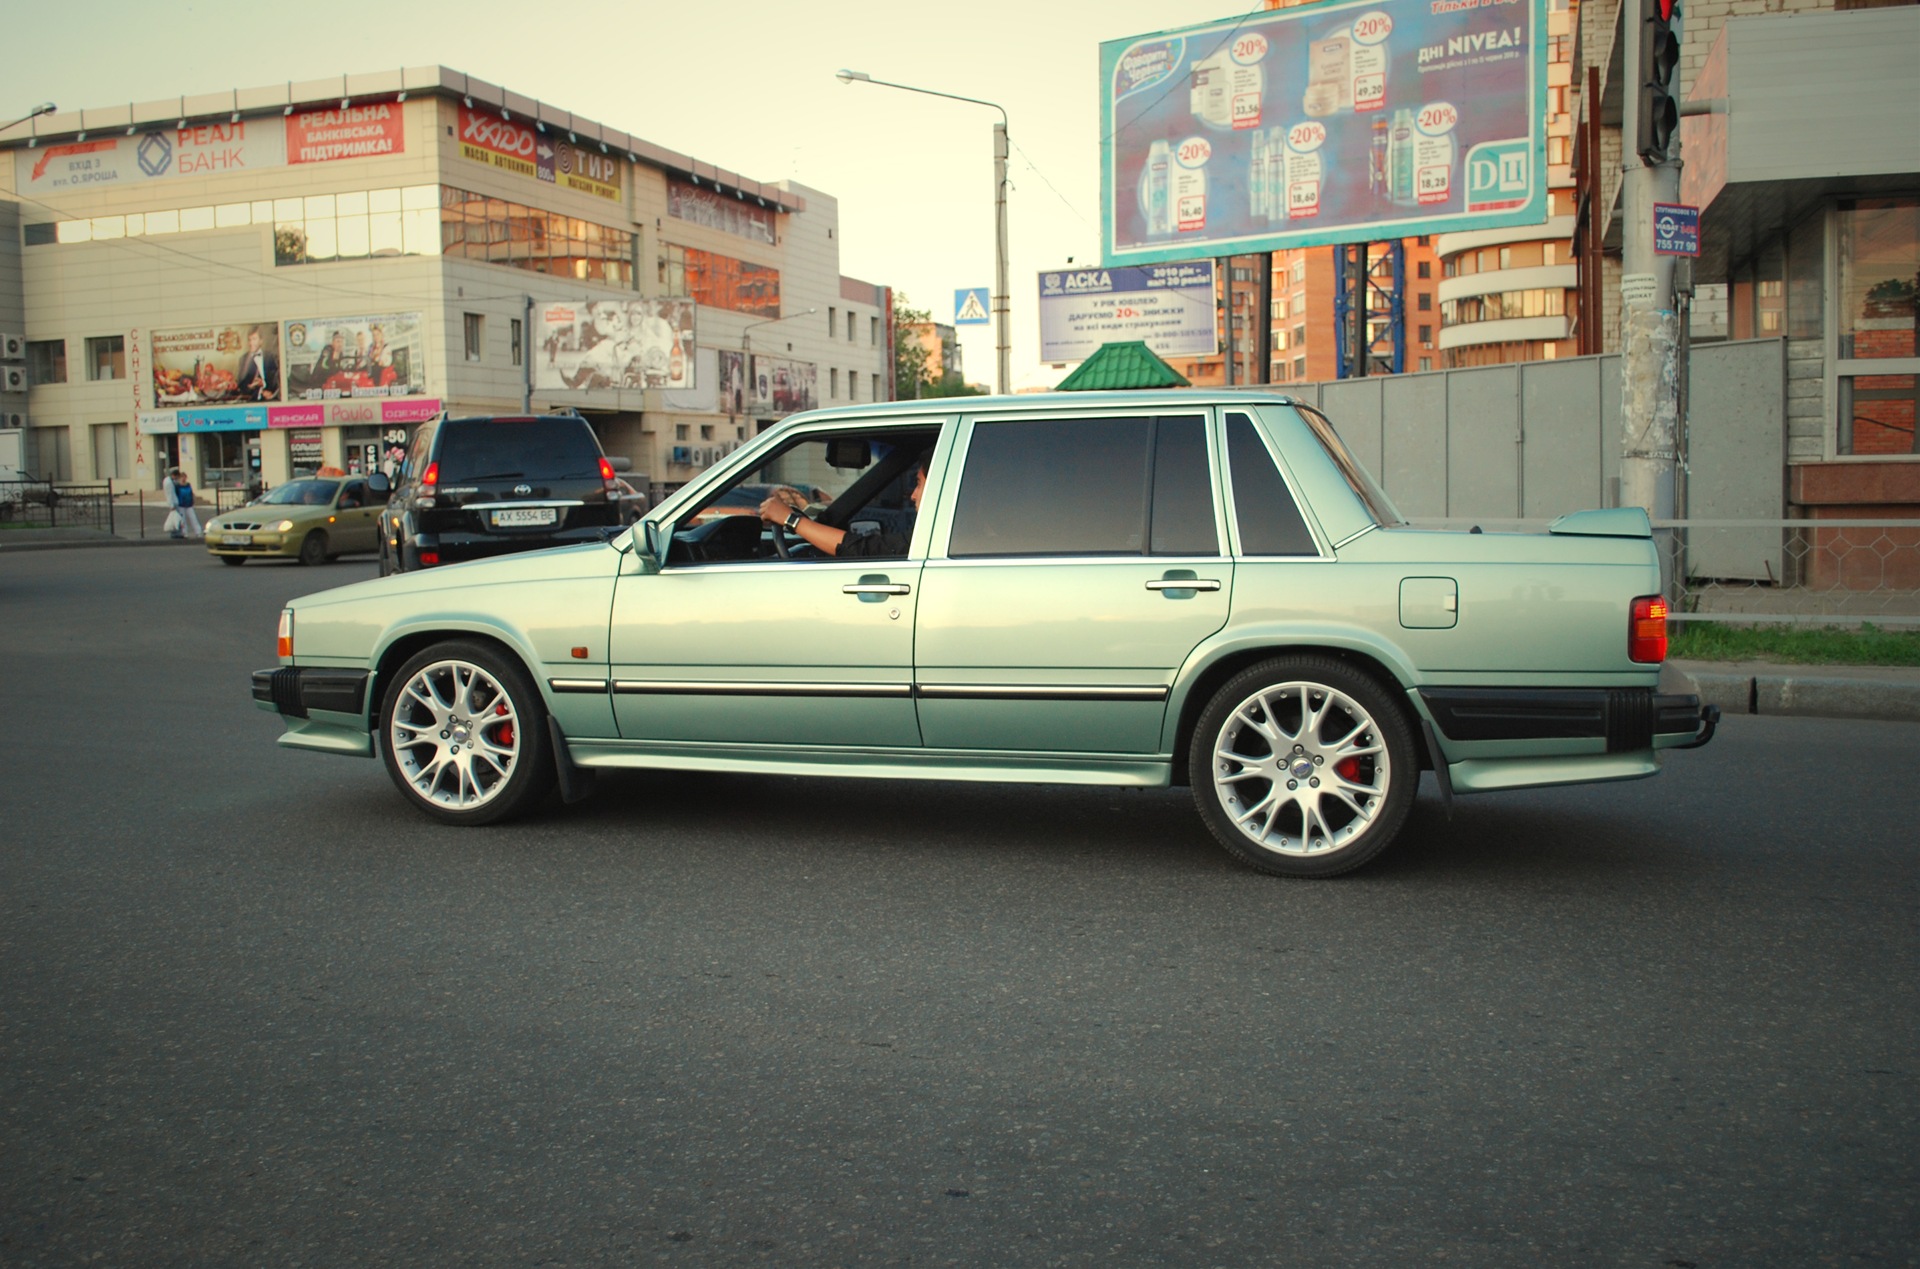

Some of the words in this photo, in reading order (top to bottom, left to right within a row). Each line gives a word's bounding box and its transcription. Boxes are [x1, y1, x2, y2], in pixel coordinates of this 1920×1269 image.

[1355, 18, 1391, 37] -20%
[1233, 39, 1267, 57] -20%
[1418, 45, 1444, 64] ДНІ
[1448, 27, 1521, 56] NIVEA!
[1358, 85, 1383, 97] 49,20
[300, 104, 391, 128] РЕАЛЬНА
[1234, 104, 1259, 116] 33,56
[1418, 108, 1456, 127] -20%
[177, 121, 246, 148] РЕАЛ
[306, 124, 384, 143] БАНКІВСЬКА
[1290, 126, 1325, 144] -20%
[301, 138, 393, 160] ПІДТРИМКА!
[1178, 143, 1211, 160] -20%
[69, 159, 92, 171] ВХІД
[178, 147, 246, 173] БАНК
[575, 151, 615, 182] ТИР
[71, 170, 118, 185] О.ЯРОША
[1421, 177, 1446, 190] 18,28
[1293, 192, 1316, 204] 18,60
[1655, 223, 1679, 231] VIASAT
[1656, 240, 1672, 249] 755
[1674, 241, 1685, 250] 77
[1686, 242, 1697, 252] 99
[1065, 271, 1113, 289] АСКА
[1153, 267, 1177, 278] 2010
[1167, 276, 1180, 286] 20
[1119, 297, 1158, 306] ЮВІЛЕЮ
[1068, 312, 1114, 322] ДАРУЄМО
[1116, 308, 1140, 318] 20%
[1143, 307, 1185, 316] ЗНИЖКИ
[273, 413, 319, 423] ЖЕНСКАЯ
[332, 404, 374, 421] Paula
[385, 409, 438, 419] ОДЕЖДА
[500, 511, 513, 522] AX
[515, 511, 538, 521] 5554
[540, 510, 554, 520] BE
